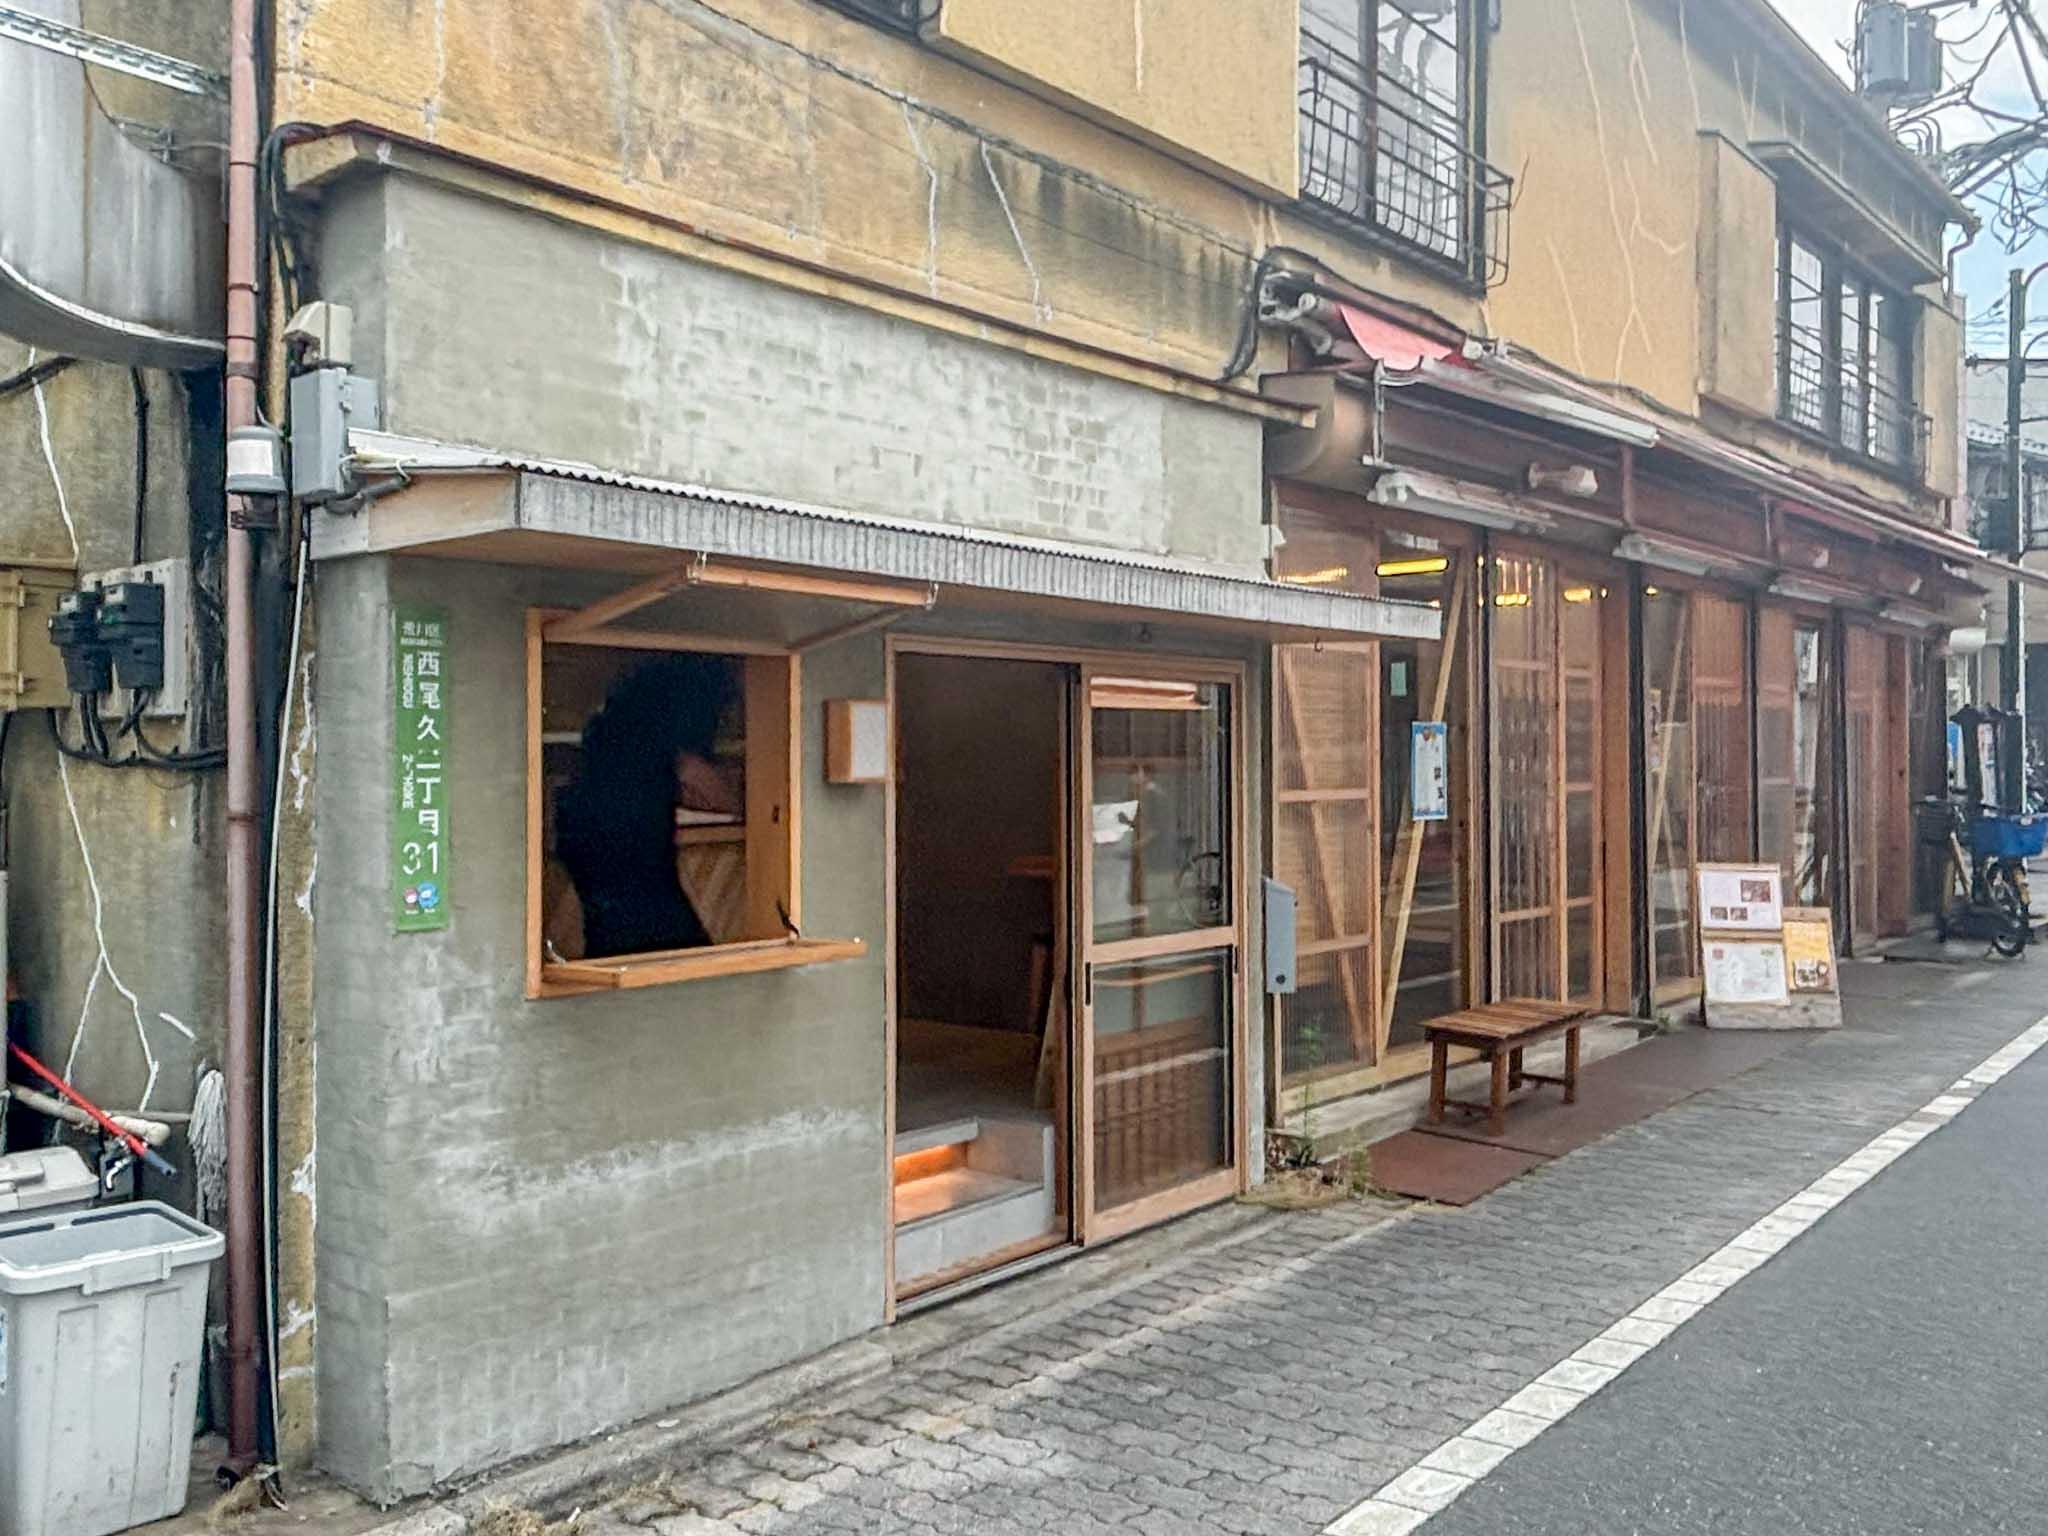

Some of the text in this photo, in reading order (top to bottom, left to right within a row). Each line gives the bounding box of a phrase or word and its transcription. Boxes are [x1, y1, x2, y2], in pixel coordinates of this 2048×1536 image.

[416, 651, 441, 837] 西尾久二丁目
[402, 842, 438, 875] 31
